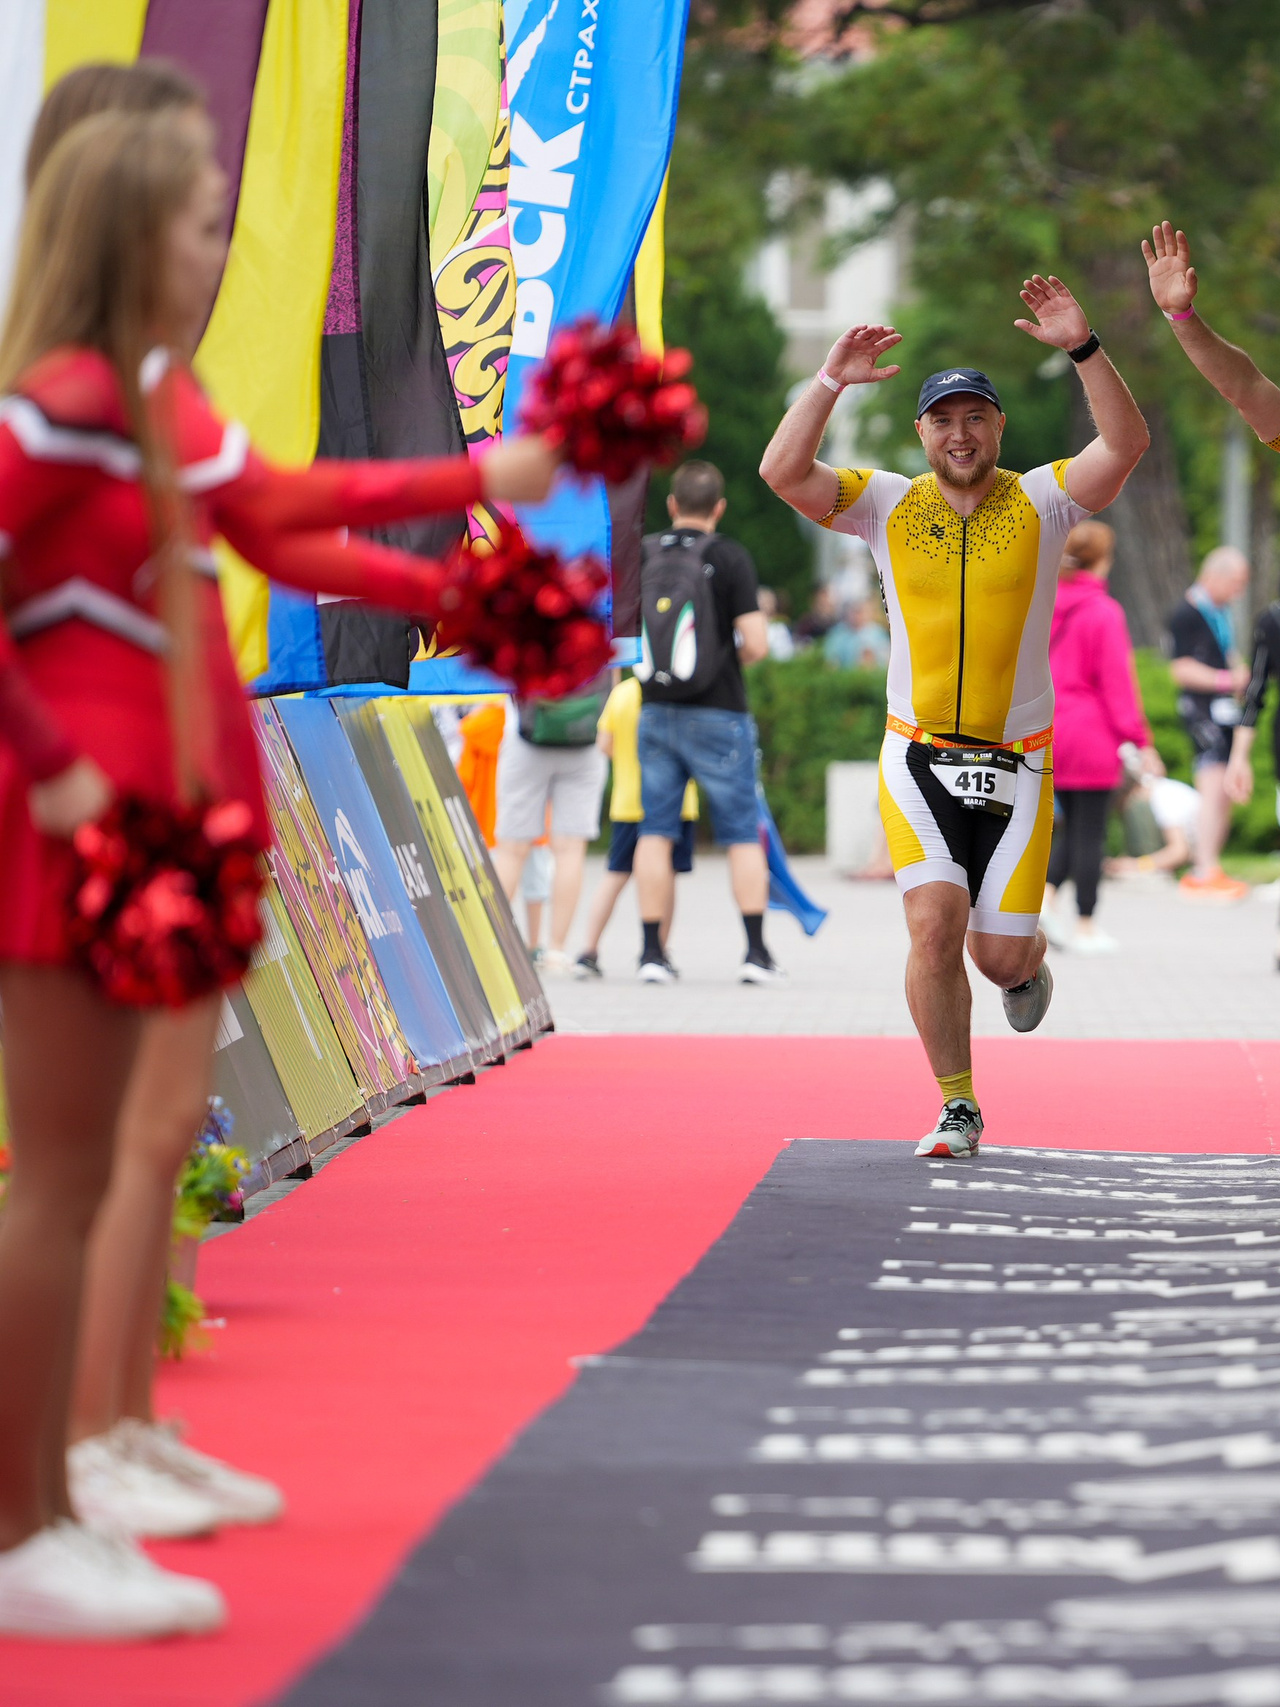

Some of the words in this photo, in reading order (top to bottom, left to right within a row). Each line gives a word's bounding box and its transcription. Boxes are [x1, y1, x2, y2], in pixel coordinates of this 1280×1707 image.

[566, 0, 600, 115] СТРАХ
[955, 771, 996, 795] 415
[963, 798, 987, 807] MARAT
